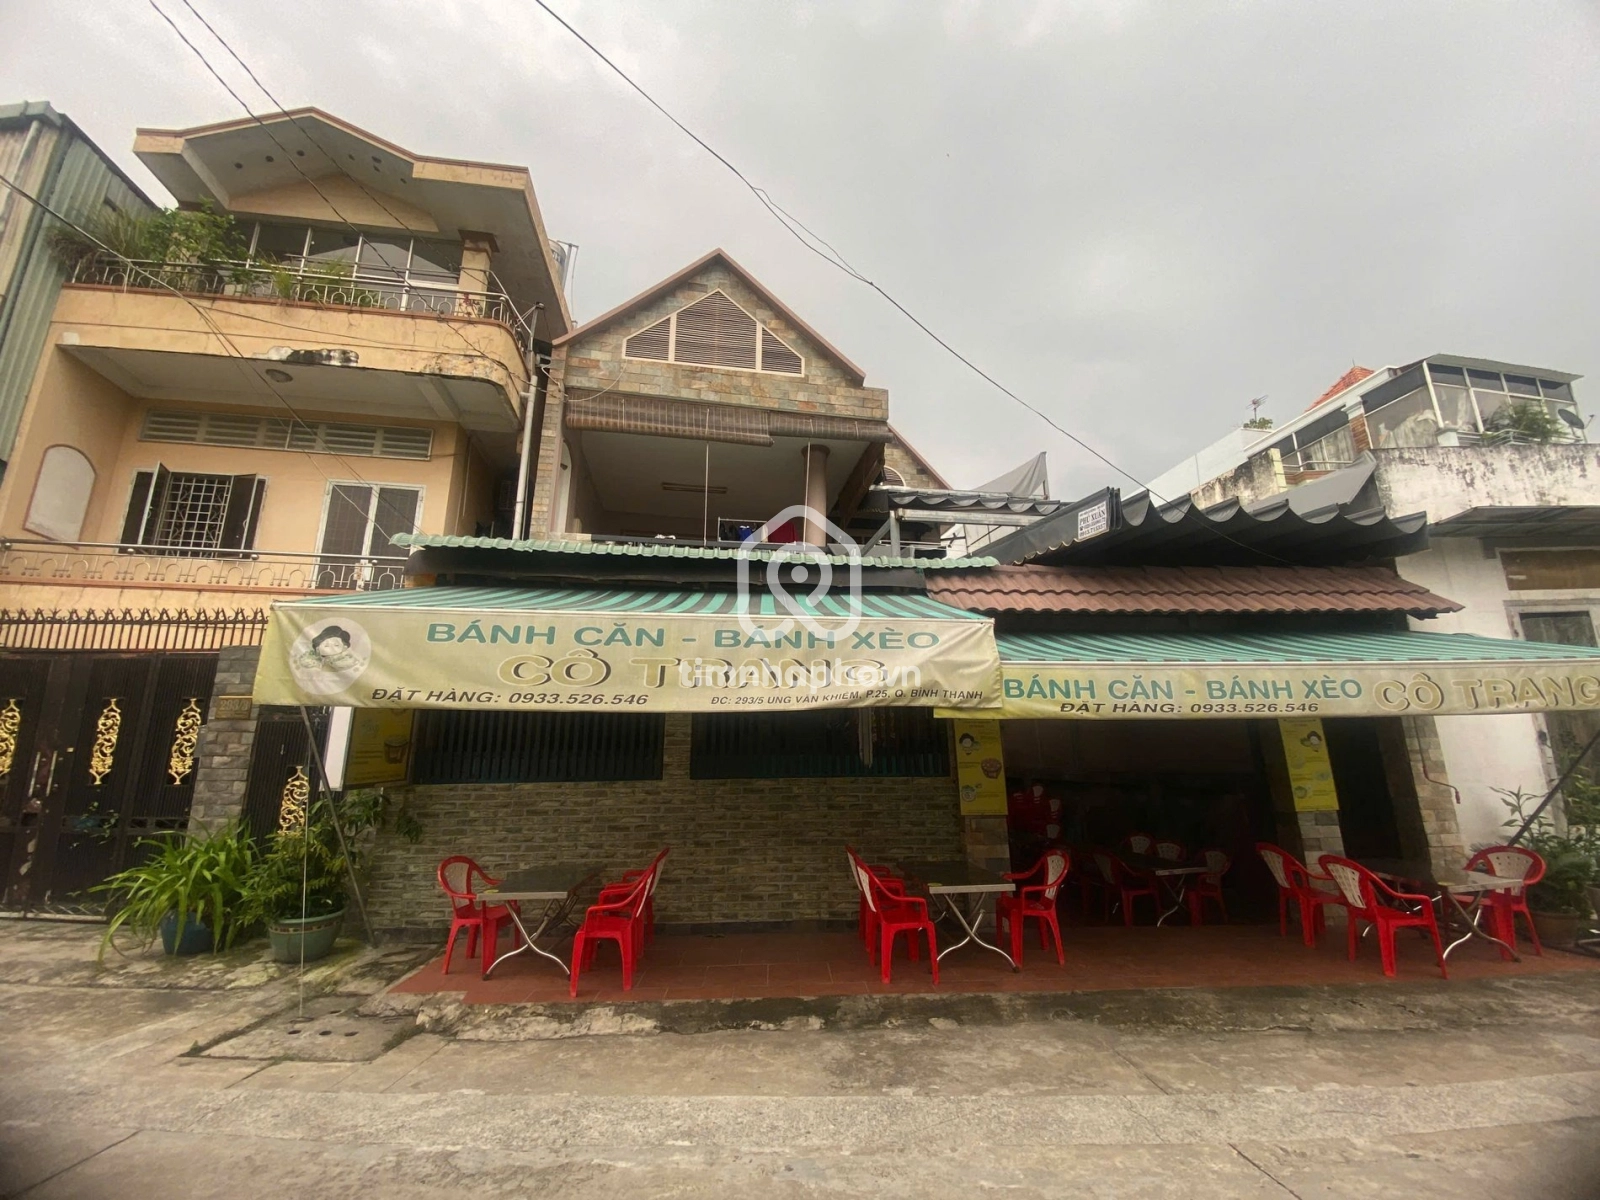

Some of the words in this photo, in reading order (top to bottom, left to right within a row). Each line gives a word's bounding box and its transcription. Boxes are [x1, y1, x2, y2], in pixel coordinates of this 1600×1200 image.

[426, 619, 556, 646] BÁNH
[573, 621, 665, 648] CĂN
[714, 625, 836, 650] BÁNH
[851, 627, 940, 650] XÈO
[497, 648, 612, 688] CÔ
[629, 656, 889, 690] TRANG
[371, 686, 421, 703] ĐẶT
[426, 687, 501, 704] HÀNG:
[509, 692, 649, 706] 0933.526.546
[1003, 673, 1096, 700] BÁNH
[1108, 674, 1173, 700] CĂN
[1206, 674, 1293, 700] BÁNH
[1302, 674, 1362, 700] XÈO
[1373, 672, 1445, 711] CÔ
[1452, 674, 1600, 711] TRANG
[711, 696, 731, 705] ĐC:
[735, 696, 764, 705] 293/5
[1060, 701, 1106, 715] ĐẶT
[1112, 701, 1182, 714] HÀNG:
[1190, 703, 1319, 714] 0933.526.546
